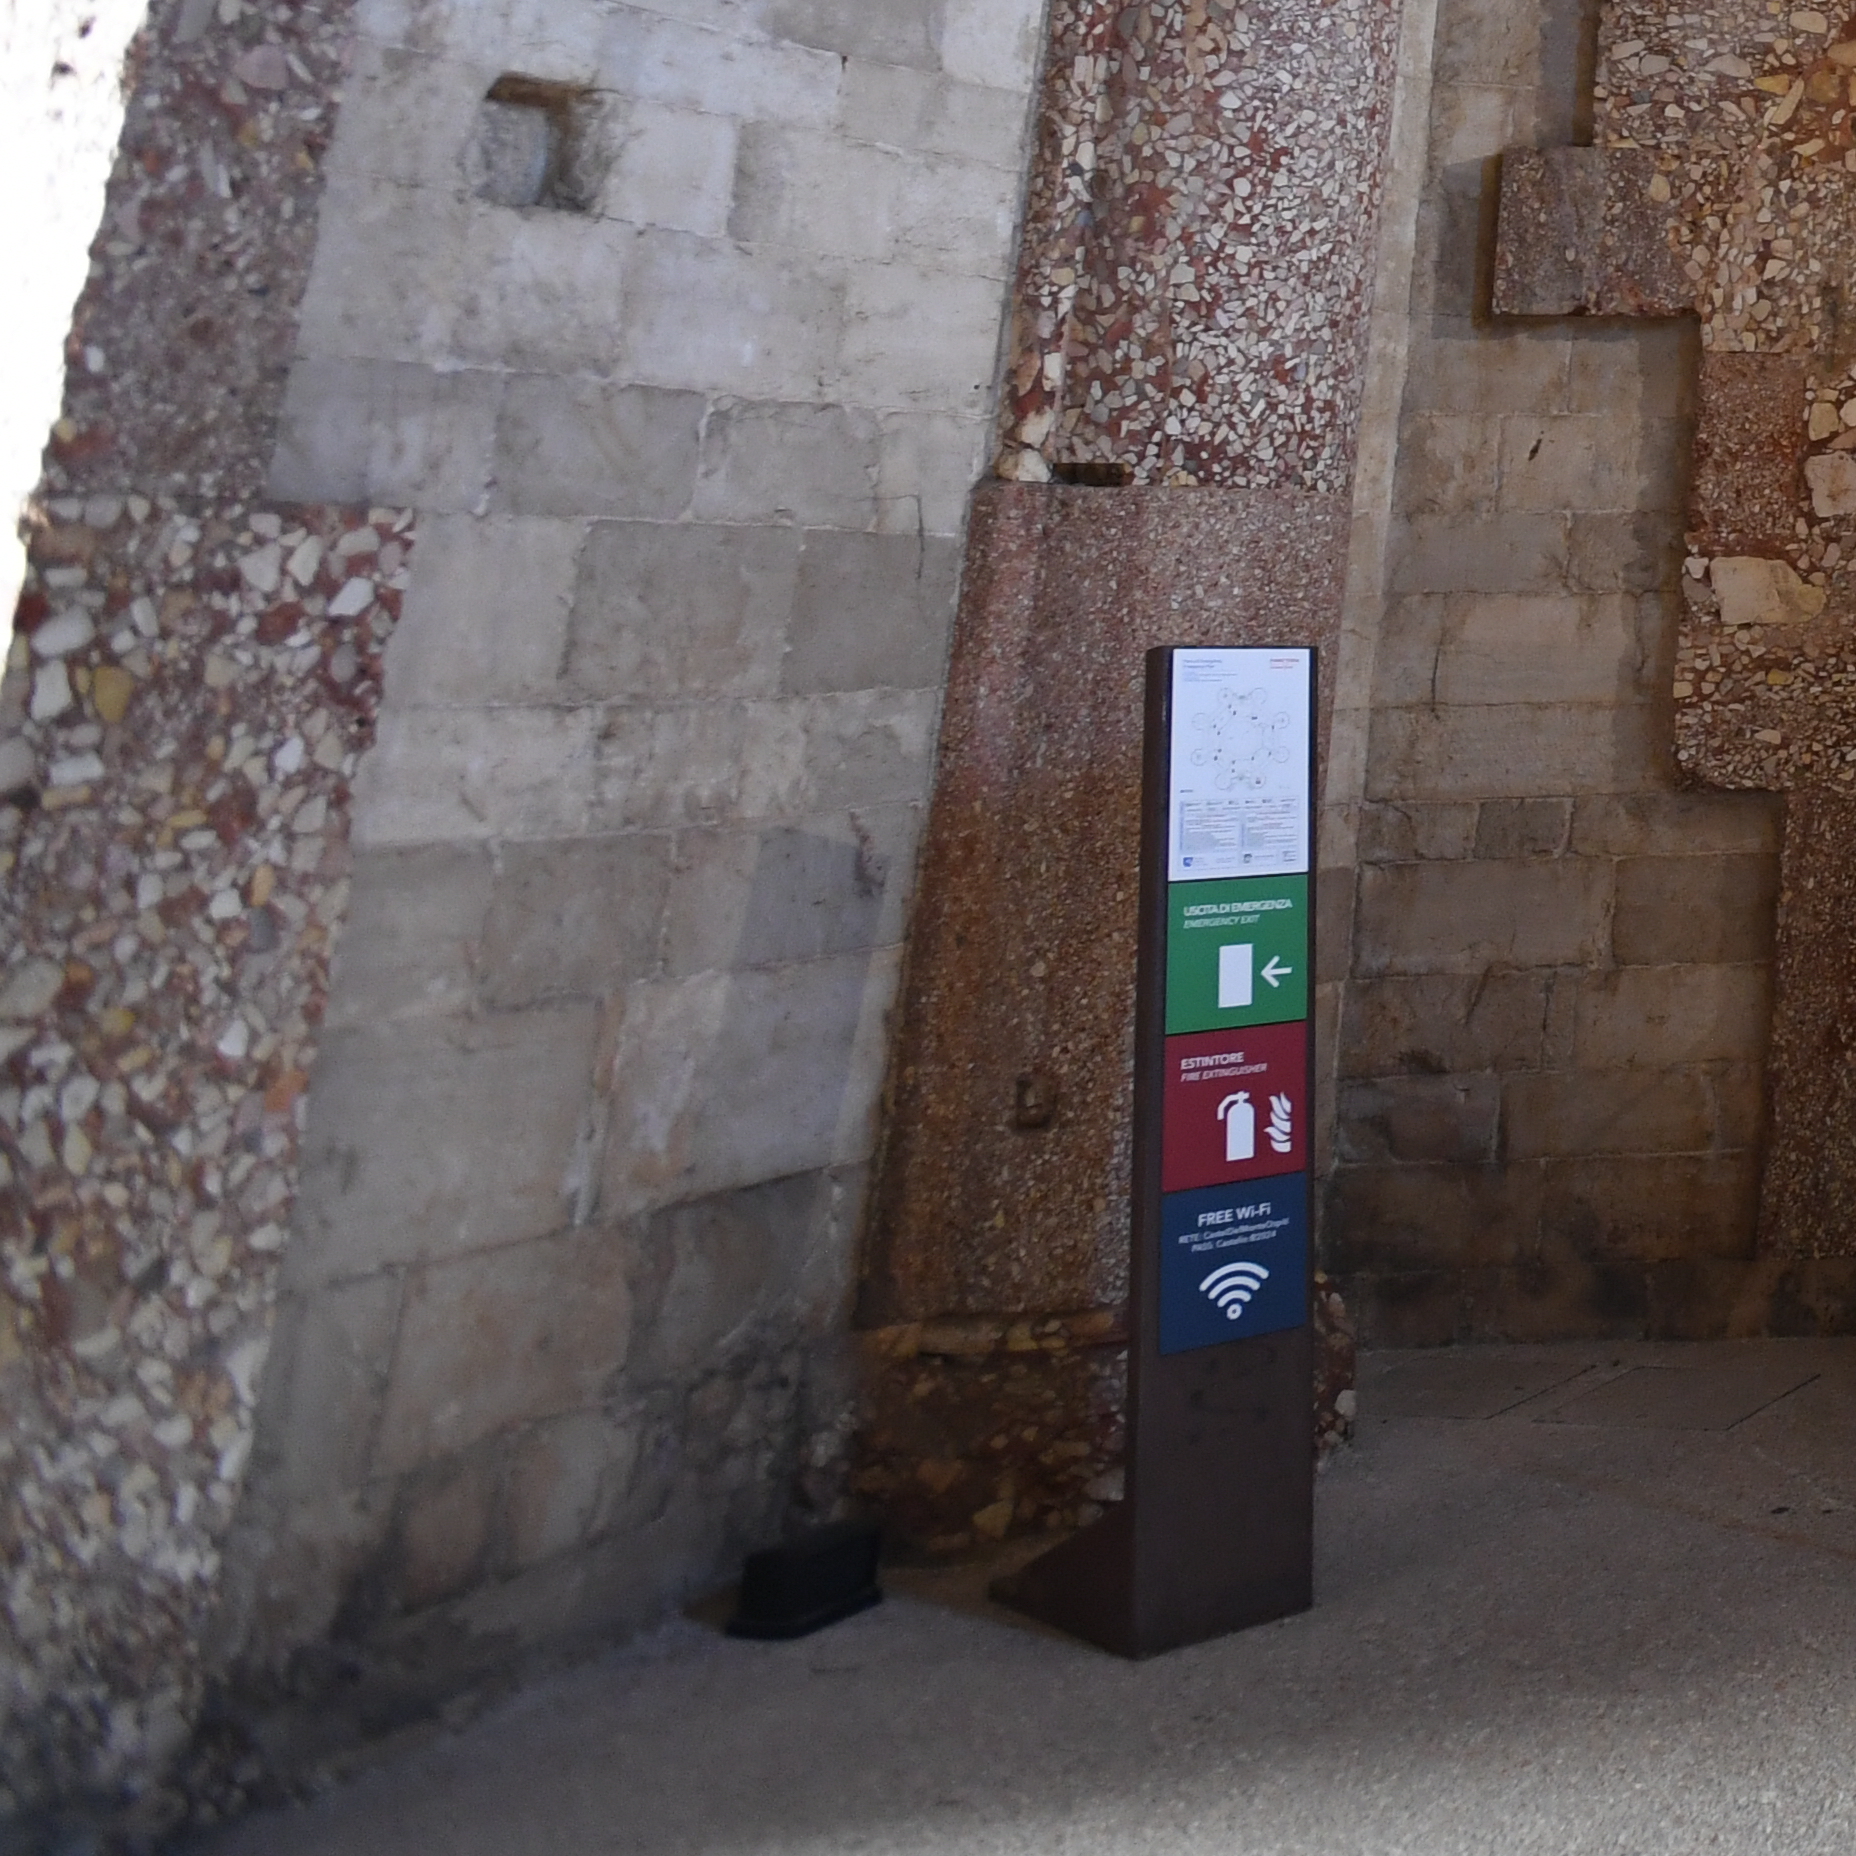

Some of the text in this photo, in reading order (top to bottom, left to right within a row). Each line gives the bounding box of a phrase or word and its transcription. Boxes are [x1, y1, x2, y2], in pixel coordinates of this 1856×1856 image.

[1184, 905, 1219, 916] USCITA
[1231, 899, 1293, 912] EMERGENZA
[1183, 914, 1260, 928] EMERGENCY EXIT
[1180, 1051, 1245, 1070] ESTINTORE
[1180, 1063, 1268, 1082] FIRE EXTINGUISHER
[1197, 1202, 1272, 1228] FREE Wi-Fi
